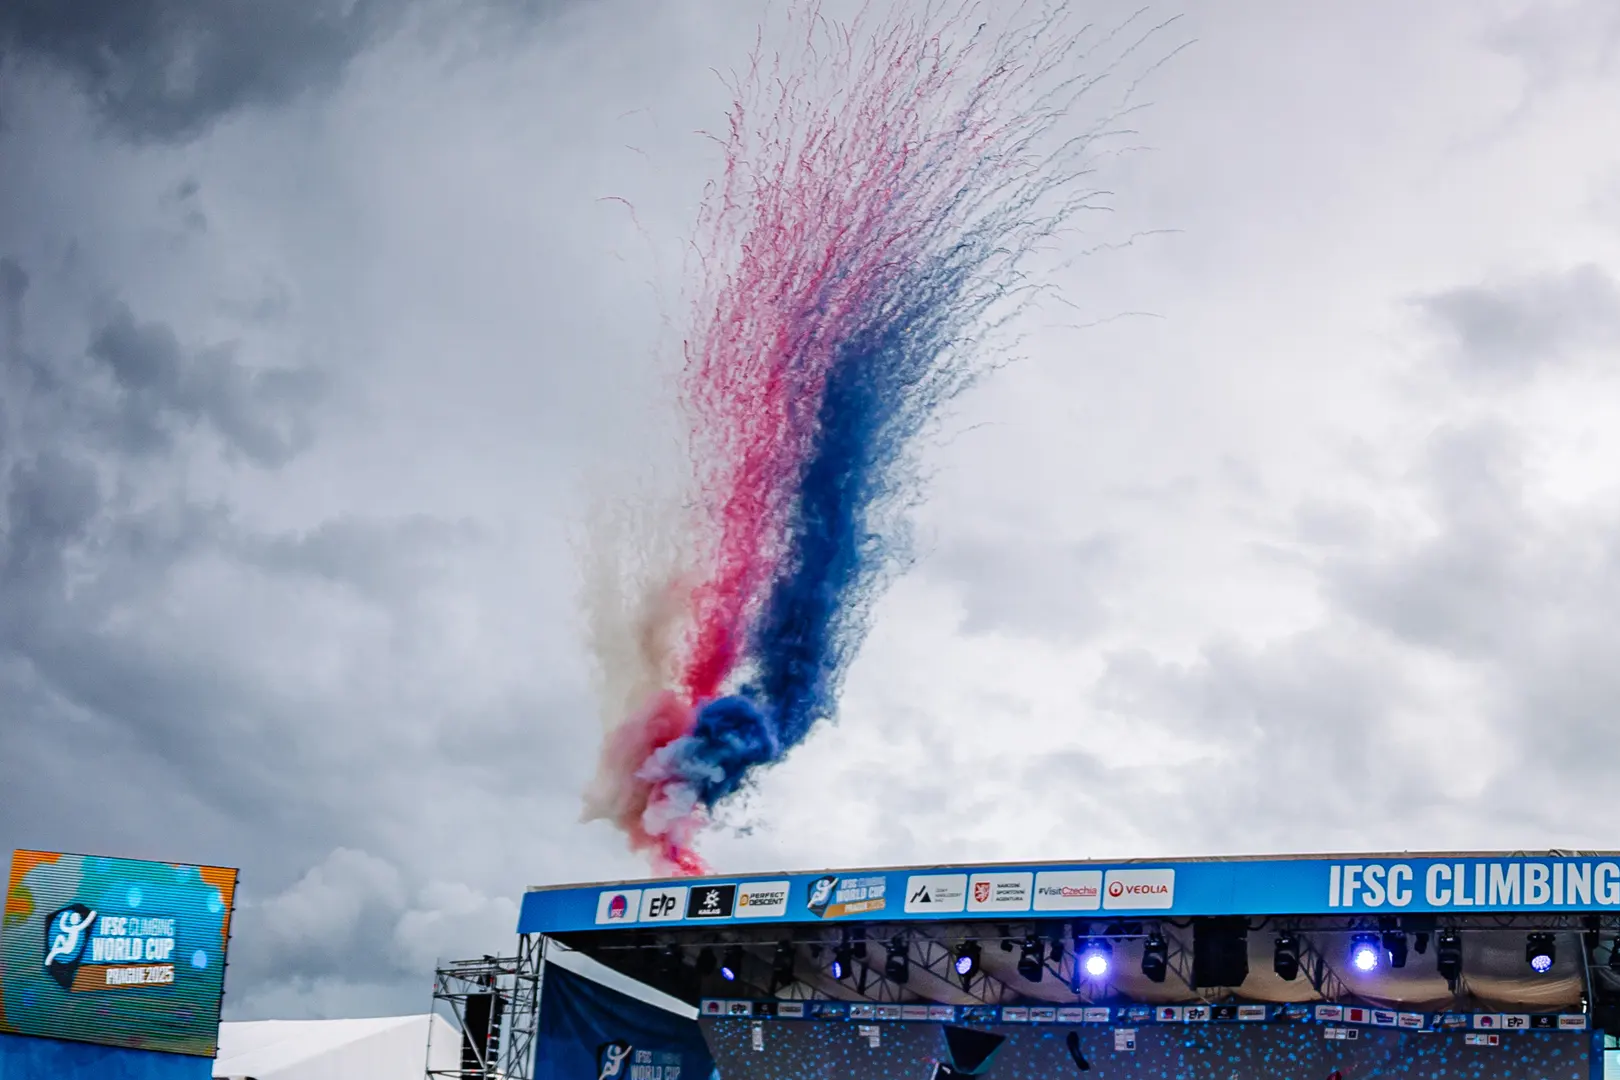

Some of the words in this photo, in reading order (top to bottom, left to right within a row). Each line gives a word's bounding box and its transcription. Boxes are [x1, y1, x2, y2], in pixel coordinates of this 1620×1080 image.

[1038, 886, 1097, 896] #VisitCzechia
[1126, 885, 1168, 894] VEOLIA
[1328, 864, 1414, 908] IFSC
[1425, 862, 1620, 907] CLIMBING
[868, 886, 886, 899] CUP
[749, 898, 784, 906] DESCENT
[100, 916, 128, 936] IFSC
[92, 938, 143, 961] WORLD
[145, 938, 175, 960] CUP
[630, 1065, 662, 1080] WORLD
[664, 1066, 681, 1080] CUP
